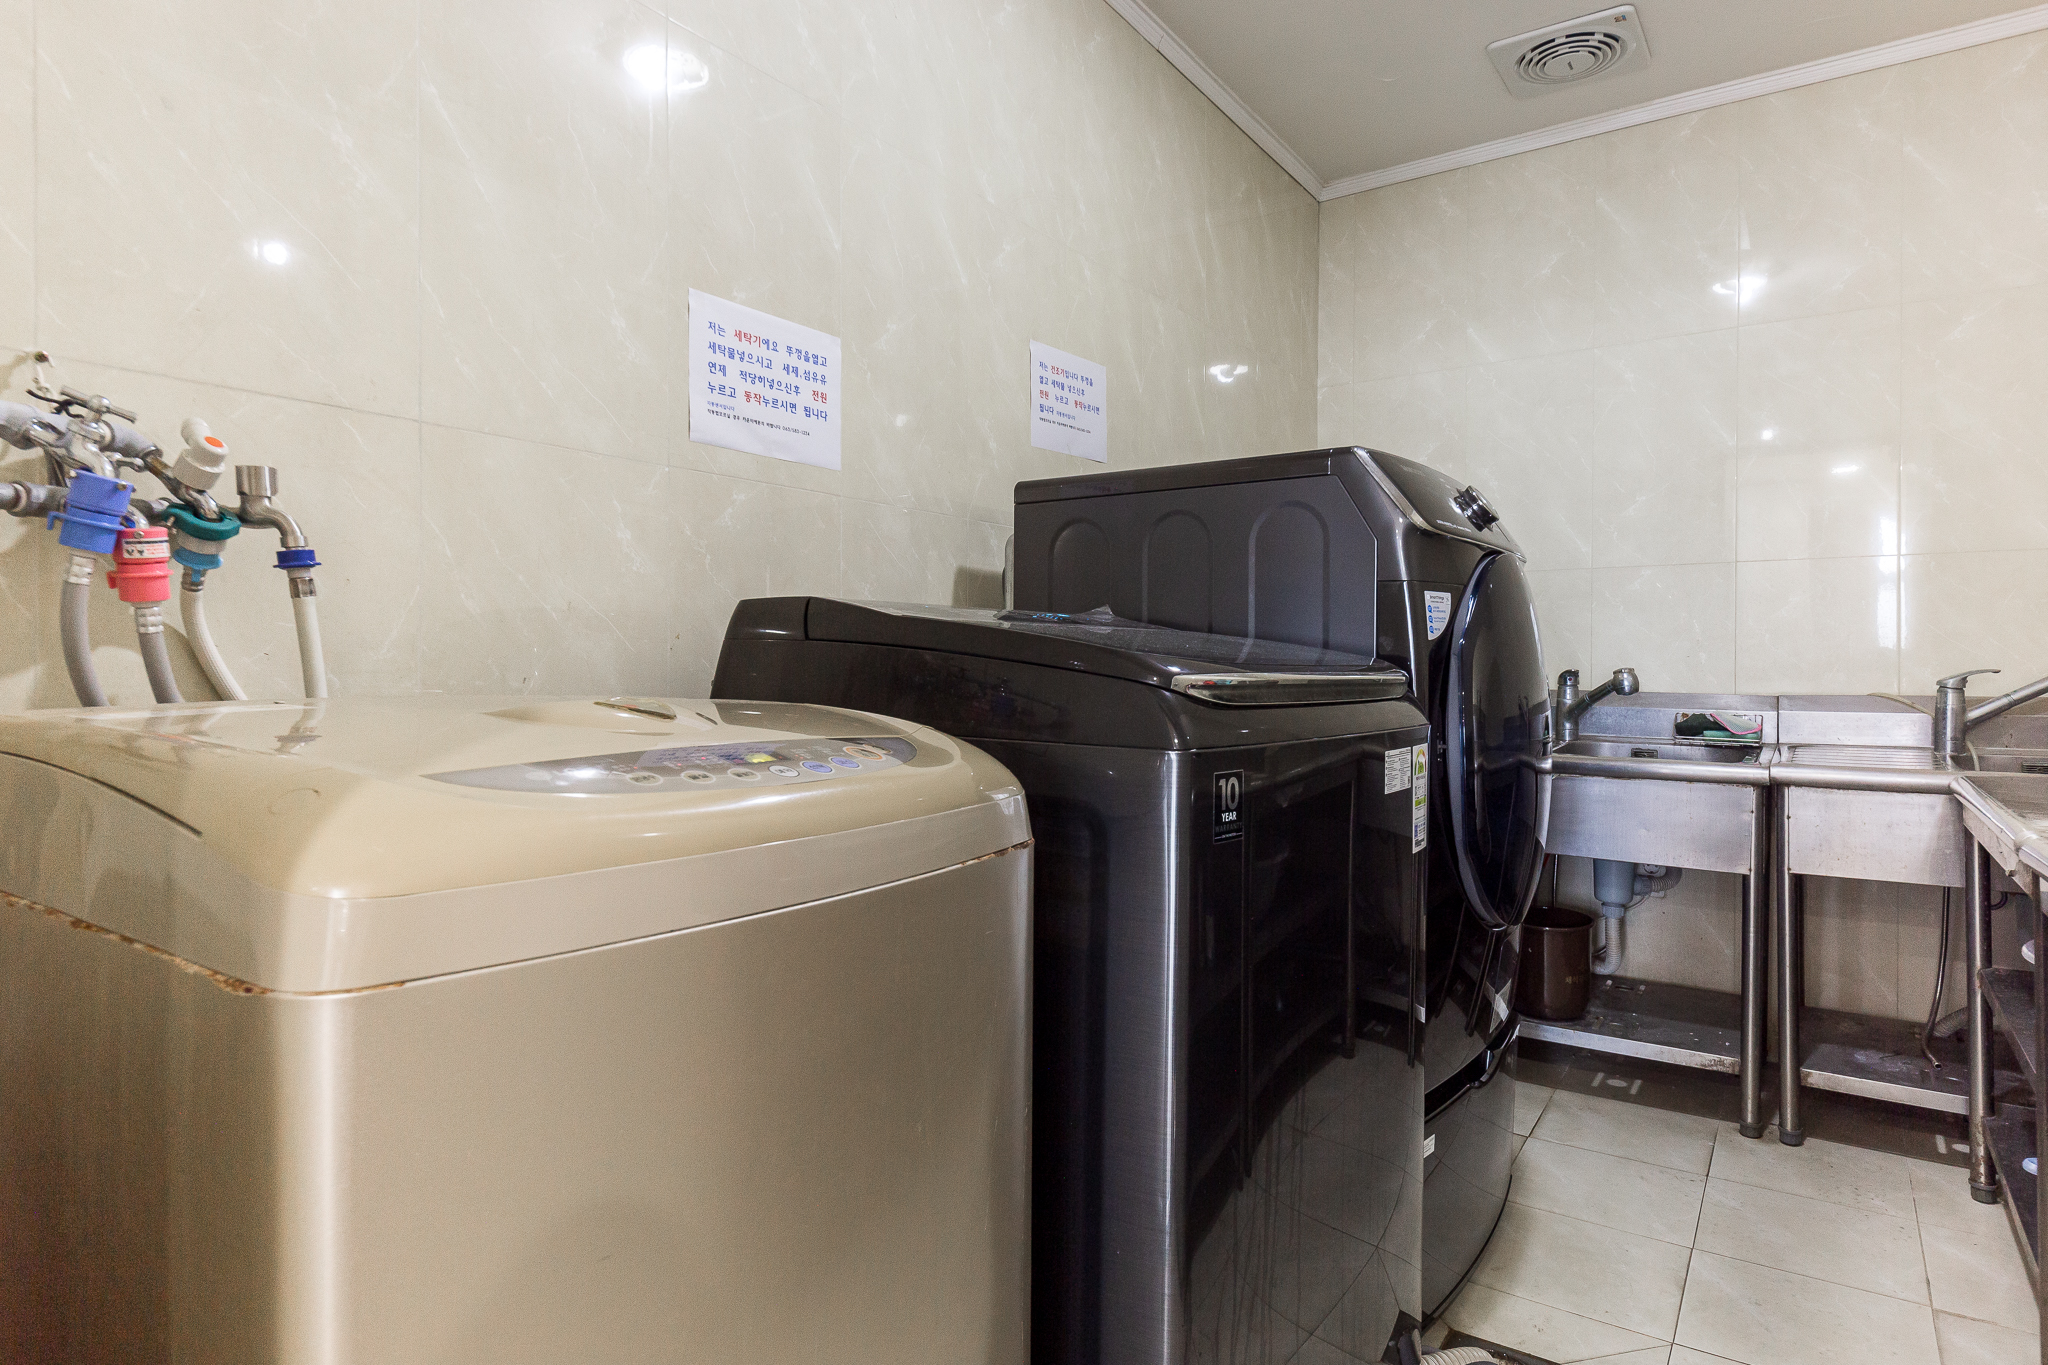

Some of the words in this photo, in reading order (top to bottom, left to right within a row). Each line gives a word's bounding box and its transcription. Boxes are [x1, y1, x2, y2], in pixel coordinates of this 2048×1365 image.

[708, 321, 726, 337] 저는
[734, 329, 779, 352] 세탁기에요
[786, 345, 827, 367] 뚜껑을열고
[708, 341, 773, 370] 세탁물넣으시고
[708, 361, 727, 377] 연제
[739, 370, 801, 396] 적당히넣으신후
[812, 390, 828, 404] 전원
[707, 381, 737, 398] 누르고
[744, 390, 797, 414] 동작누르시면
[803, 406, 828, 422] 됩니다
[1218, 776, 1240, 810] 10
[1221, 811, 1237, 822] YEAR
